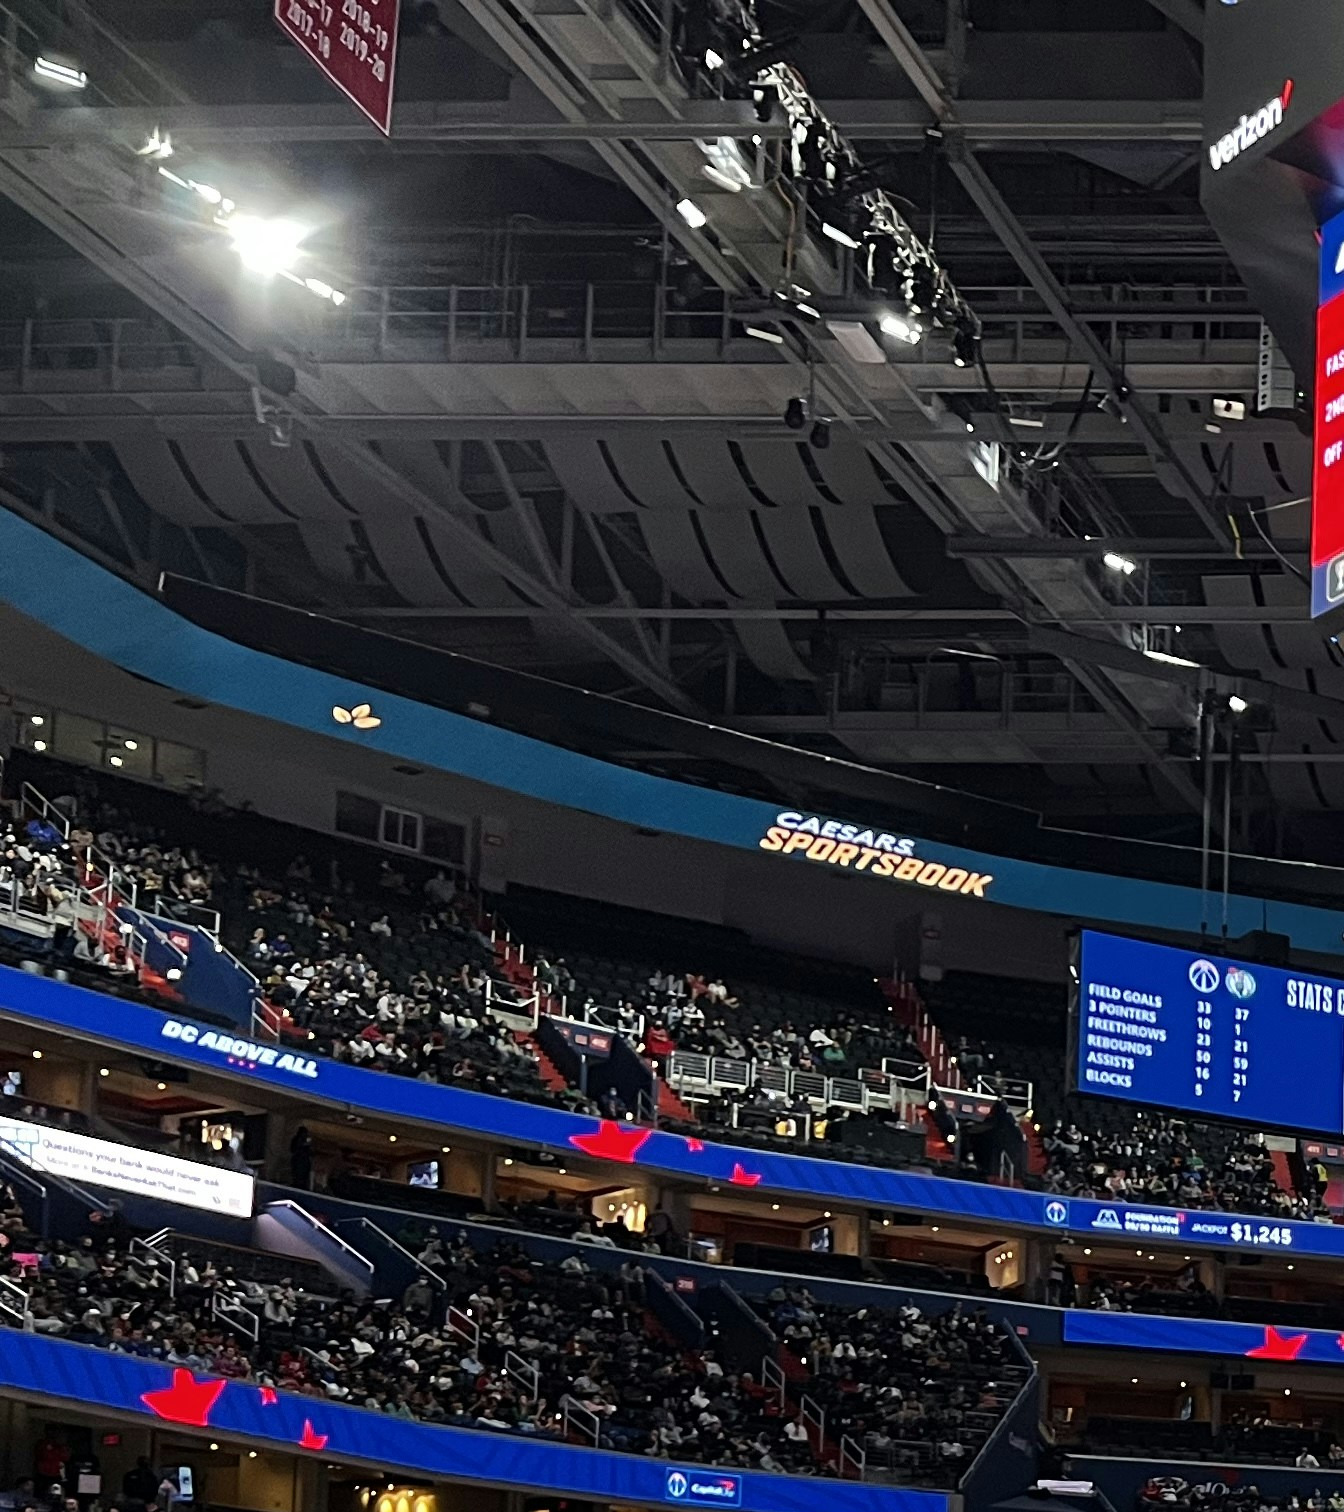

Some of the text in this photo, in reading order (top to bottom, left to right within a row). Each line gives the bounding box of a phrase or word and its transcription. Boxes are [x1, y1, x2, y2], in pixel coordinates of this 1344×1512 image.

[1208, 96, 1284, 171] verizon
[1323, 436, 1343, 467] OFF
[775, 810, 915, 857] CAESARS
[760, 825, 994, 898] SPORTSBOOK
[1286, 978, 1333, 1014] STATS
[161, 1020, 318, 1078] DC ABOVE ALL
[1230, 1222, 1292, 1245] $1,245
